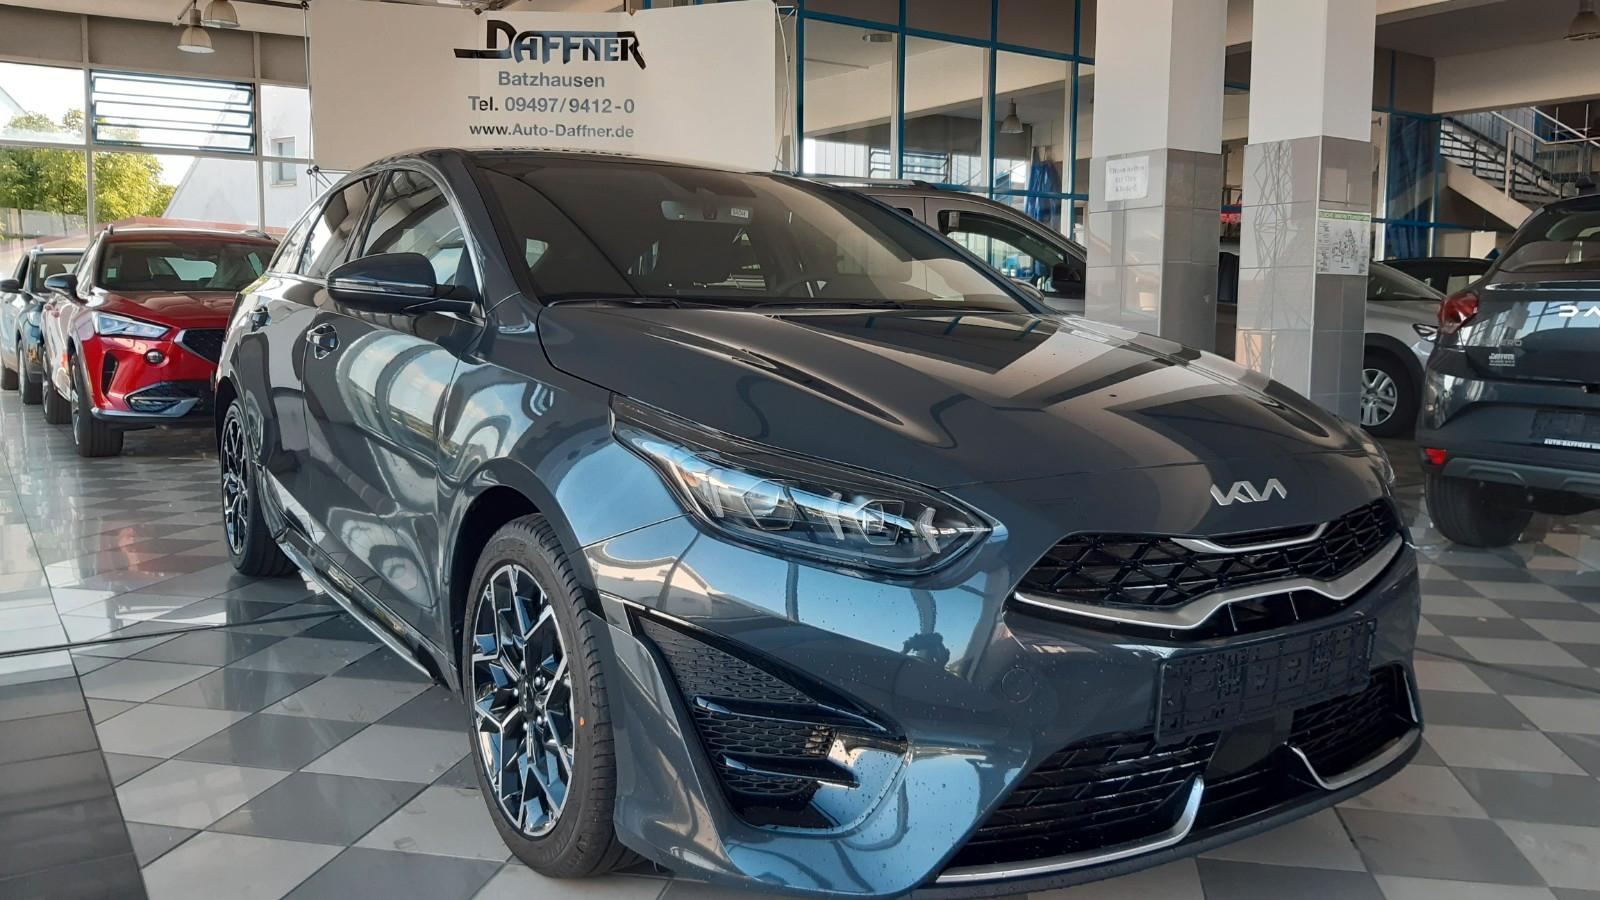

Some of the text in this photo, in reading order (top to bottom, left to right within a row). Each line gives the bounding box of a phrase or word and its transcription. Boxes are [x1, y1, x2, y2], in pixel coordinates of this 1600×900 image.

[454, 19, 647, 70] DAFFNER
[498, 71, 605, 88] Batzhausen
[468, 96, 499, 112] Tel.
[469, 123, 635, 138] www.Auto-Daffner.de
